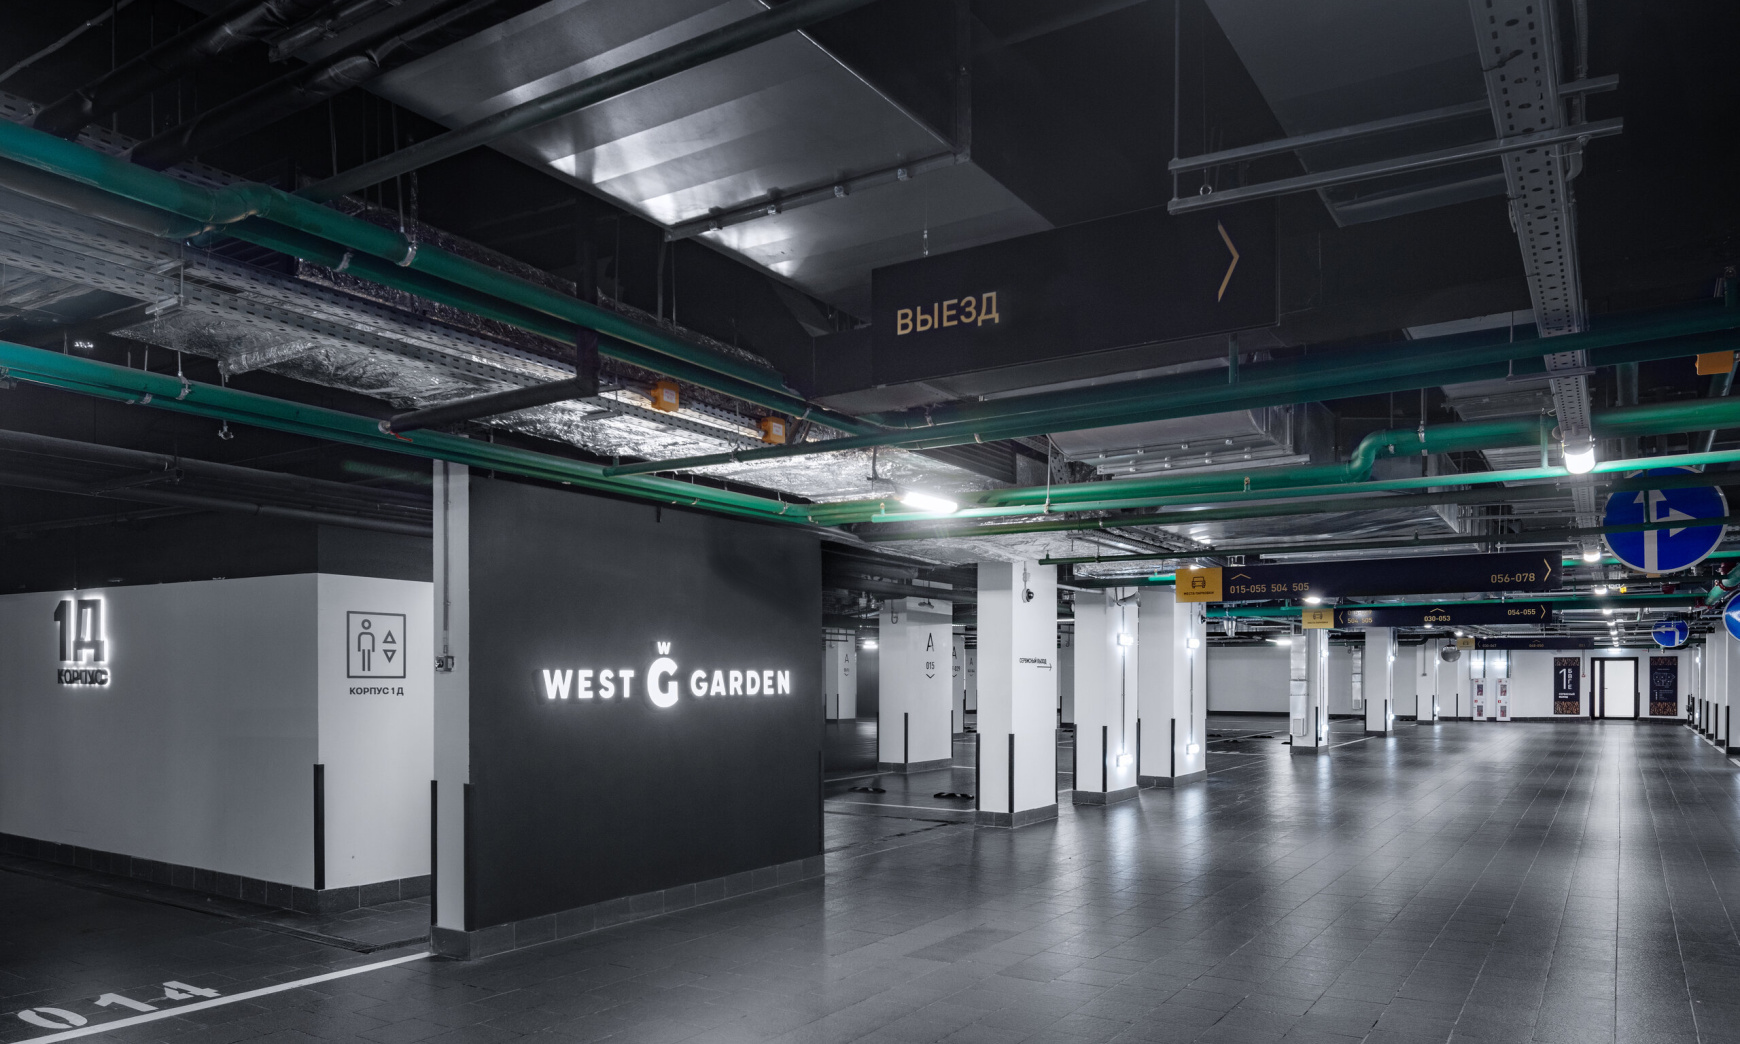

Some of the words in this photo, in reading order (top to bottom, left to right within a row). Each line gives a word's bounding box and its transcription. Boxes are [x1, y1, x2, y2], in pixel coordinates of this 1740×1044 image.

[896, 291, 1000, 335] ВЫЕЗД
[1490, 572, 1536, 583] 056-078
[1229, 584, 1267, 594] 015-055
[1271, 583, 1288, 592] 504
[1292, 582, 1310, 592] 505
[53, 598, 105, 662] 1Д
[657, 641, 671, 655] W
[926, 661, 935, 670] 015
[57, 668, 109, 685] КОРПУС
[543, 669, 635, 699] WEST
[690, 670, 791, 697] GARDEN
[1558, 668, 1567, 690] 1
[349, 687, 389, 695] КОРПУС
[18, 980, 222, 1029] 014
